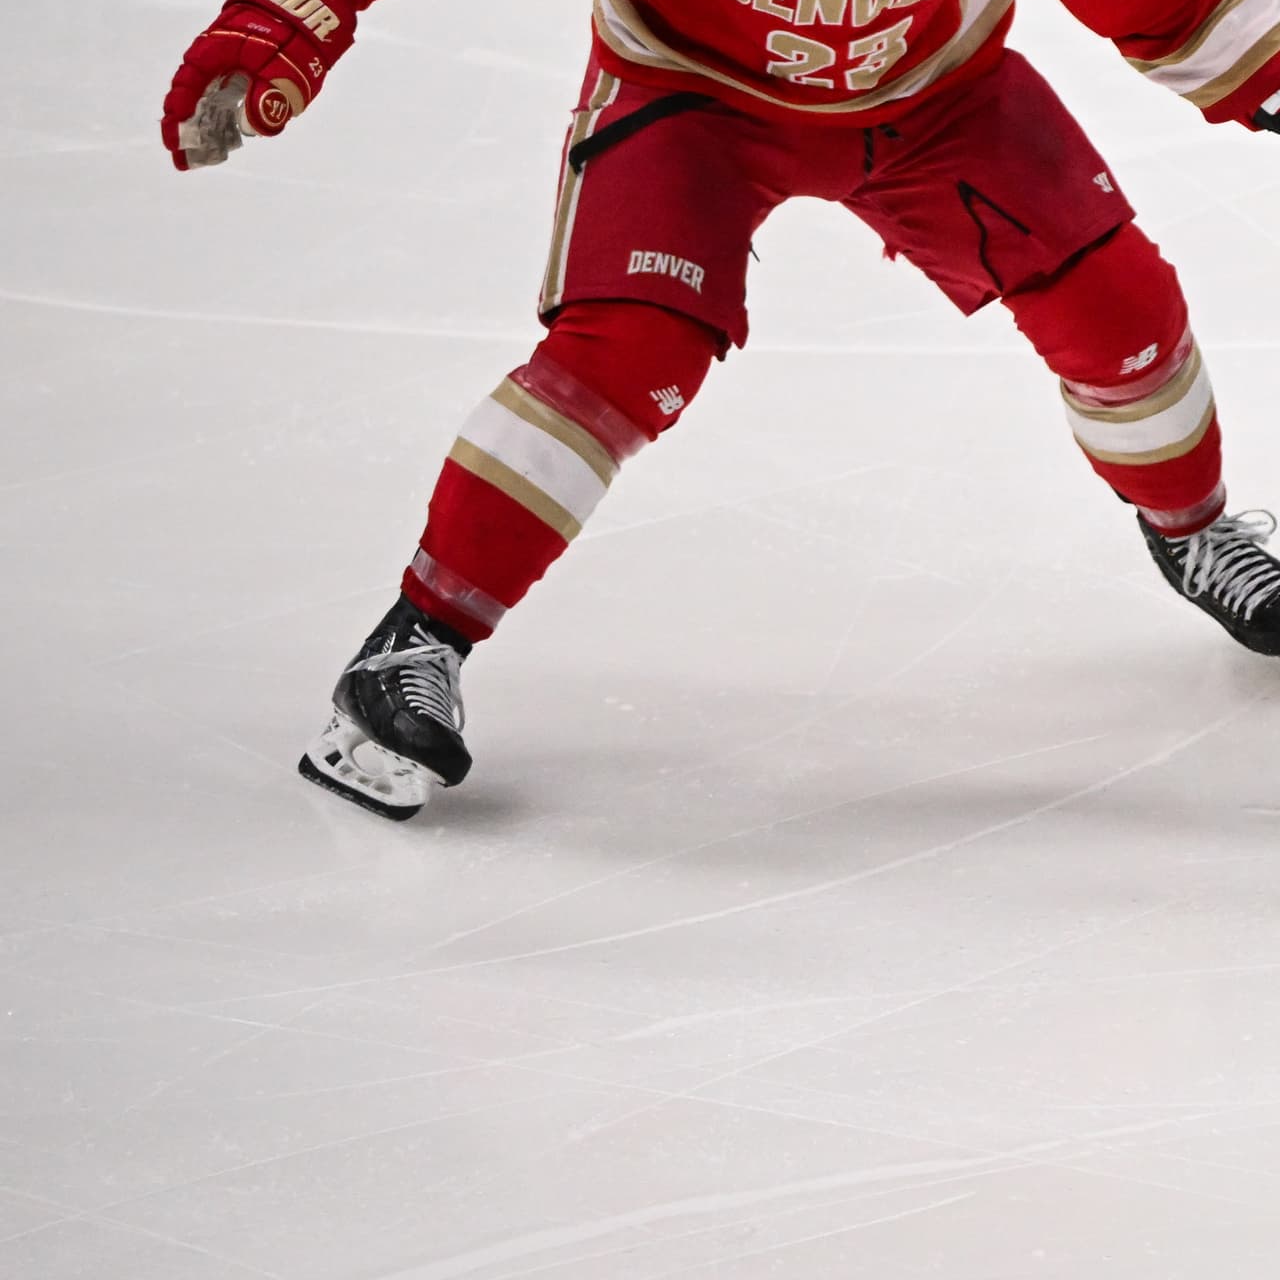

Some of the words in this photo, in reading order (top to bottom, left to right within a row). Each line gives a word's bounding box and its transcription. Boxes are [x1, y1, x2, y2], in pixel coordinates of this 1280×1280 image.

[308, 56, 324, 78] 23
[767, 14, 914, 90] 23
[626, 249, 706, 295] DENVER
